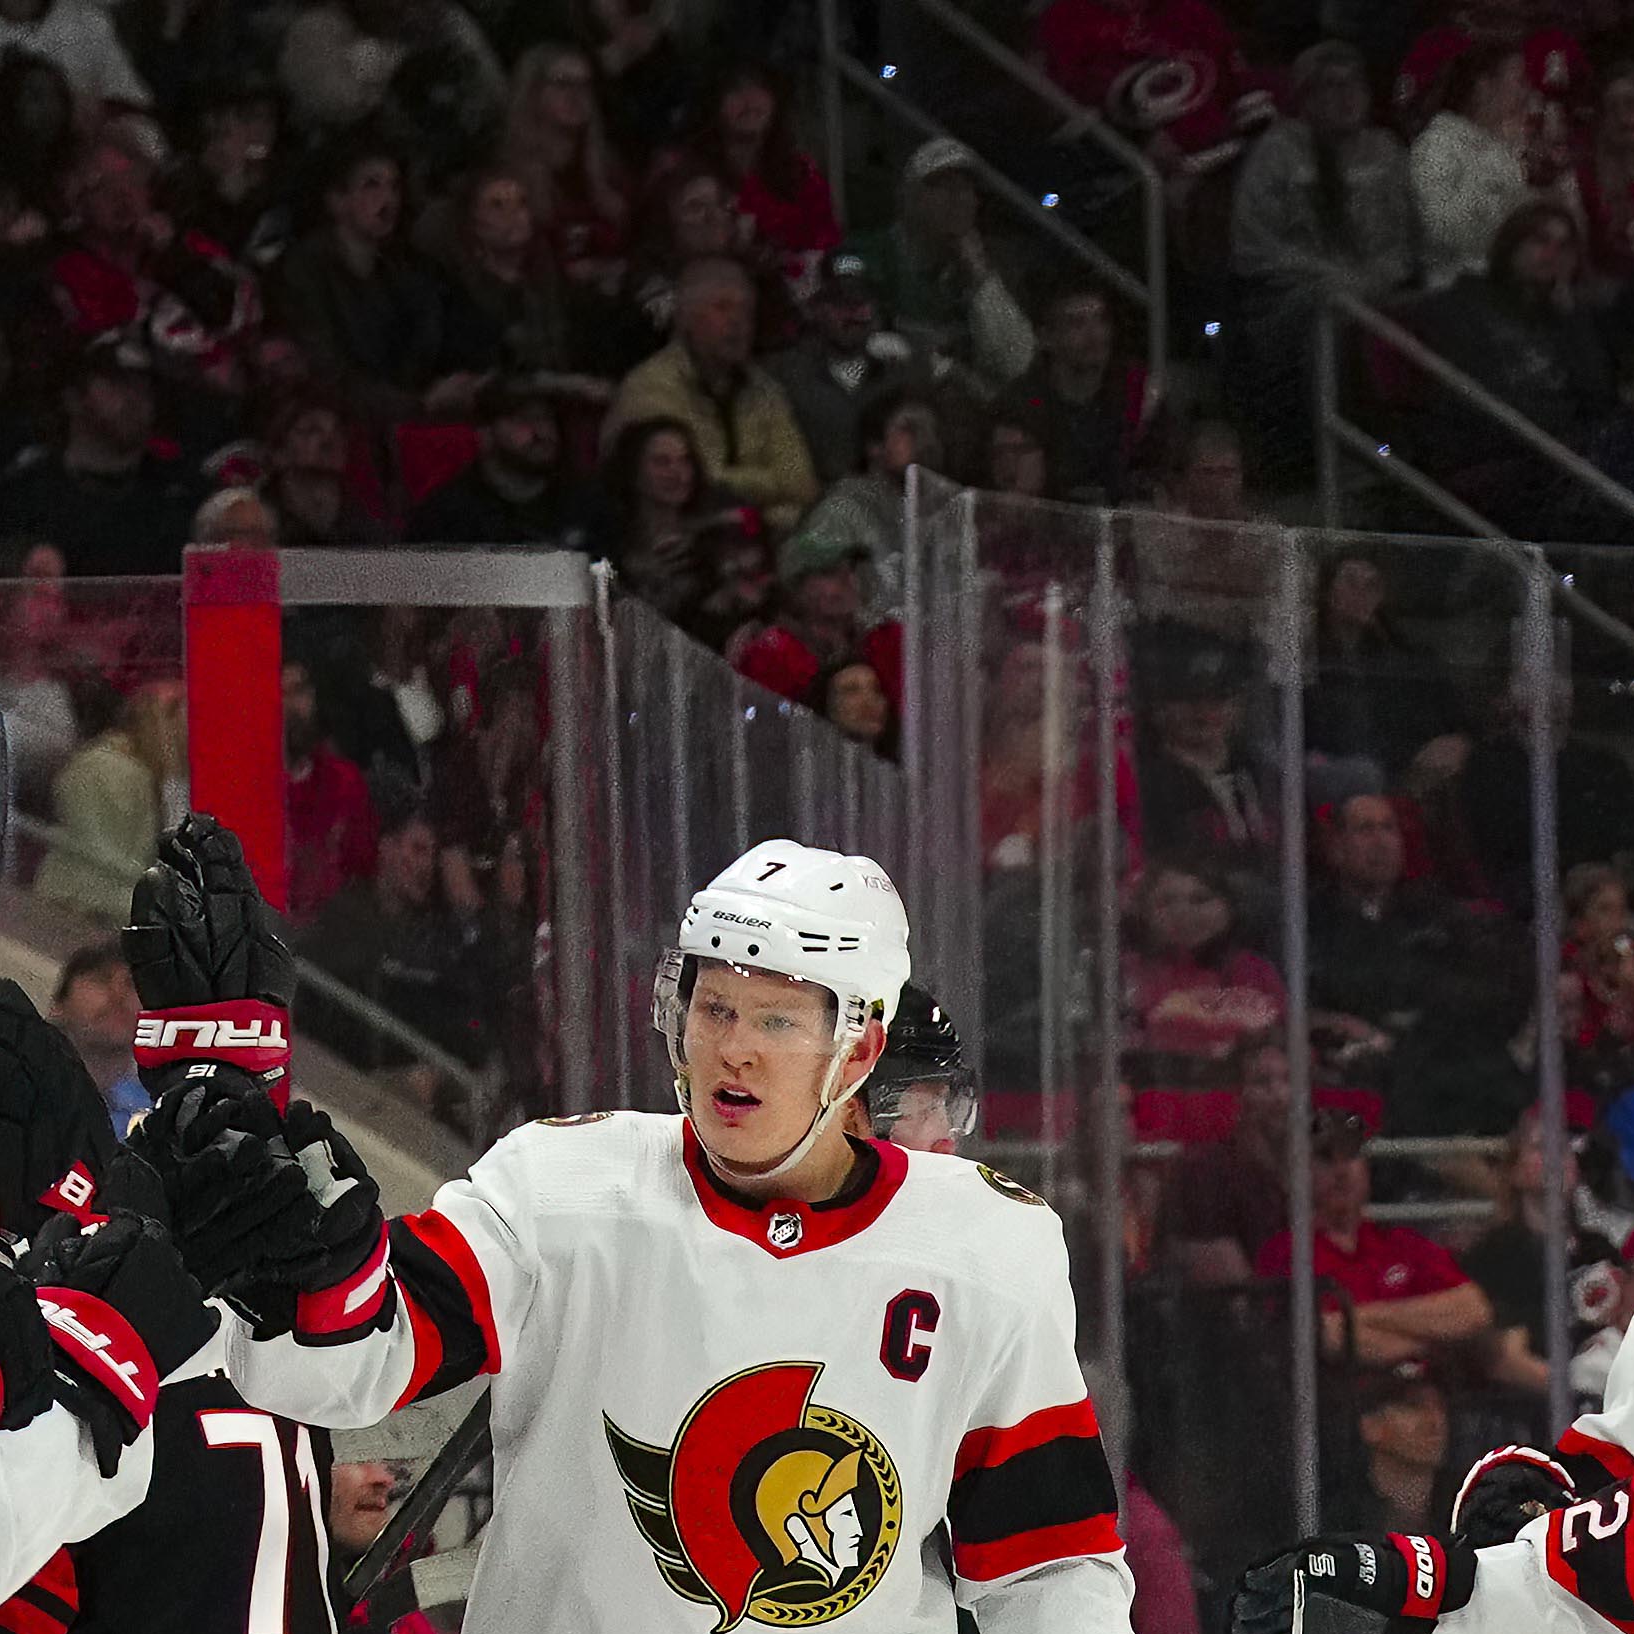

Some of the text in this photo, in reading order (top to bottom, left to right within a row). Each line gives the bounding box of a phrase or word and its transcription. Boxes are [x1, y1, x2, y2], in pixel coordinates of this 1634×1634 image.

[755, 861, 787, 883] 7
[135, 1016, 289, 1050] TRUE
[878, 1287, 942, 1383] C
